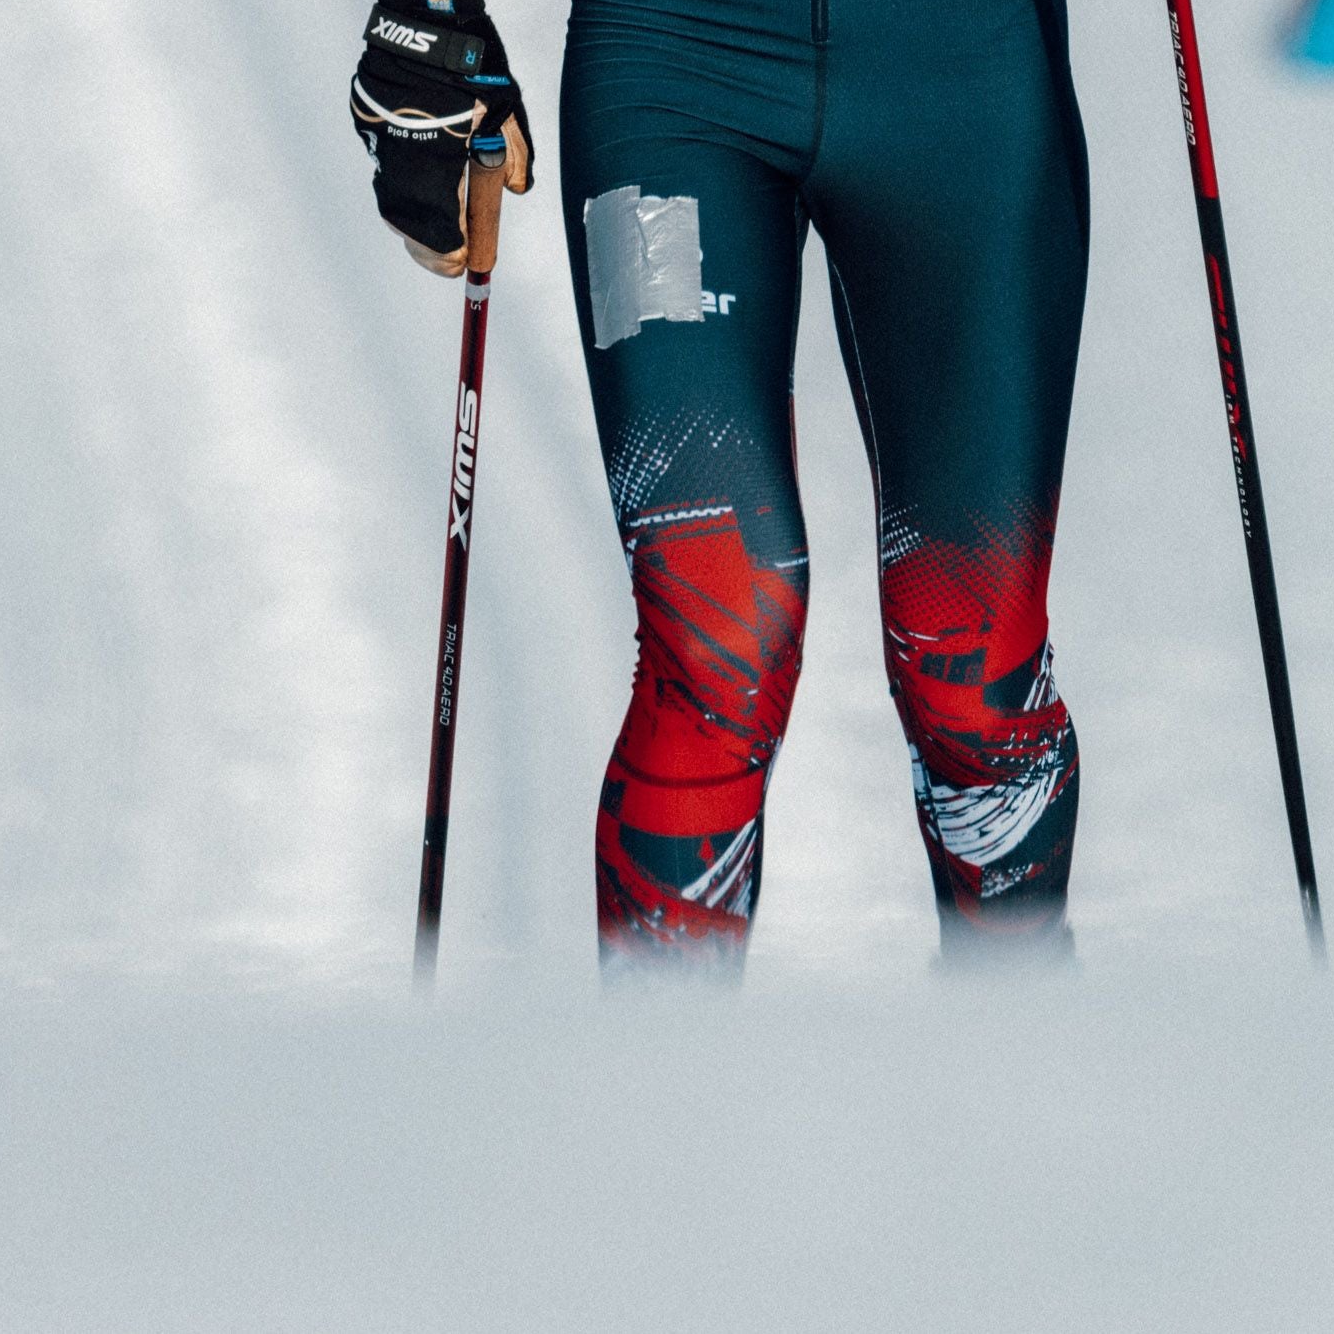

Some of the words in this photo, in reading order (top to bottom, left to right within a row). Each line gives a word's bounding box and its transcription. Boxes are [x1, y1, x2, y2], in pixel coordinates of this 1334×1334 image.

[370, 16, 438, 53] SWIX
[387, 125, 409, 139] gold
[412, 130, 438, 141] ratio
[450, 380, 478, 551] SWIX
[444, 623, 457, 665] TRIAC
[439, 686, 452, 726] AERO
